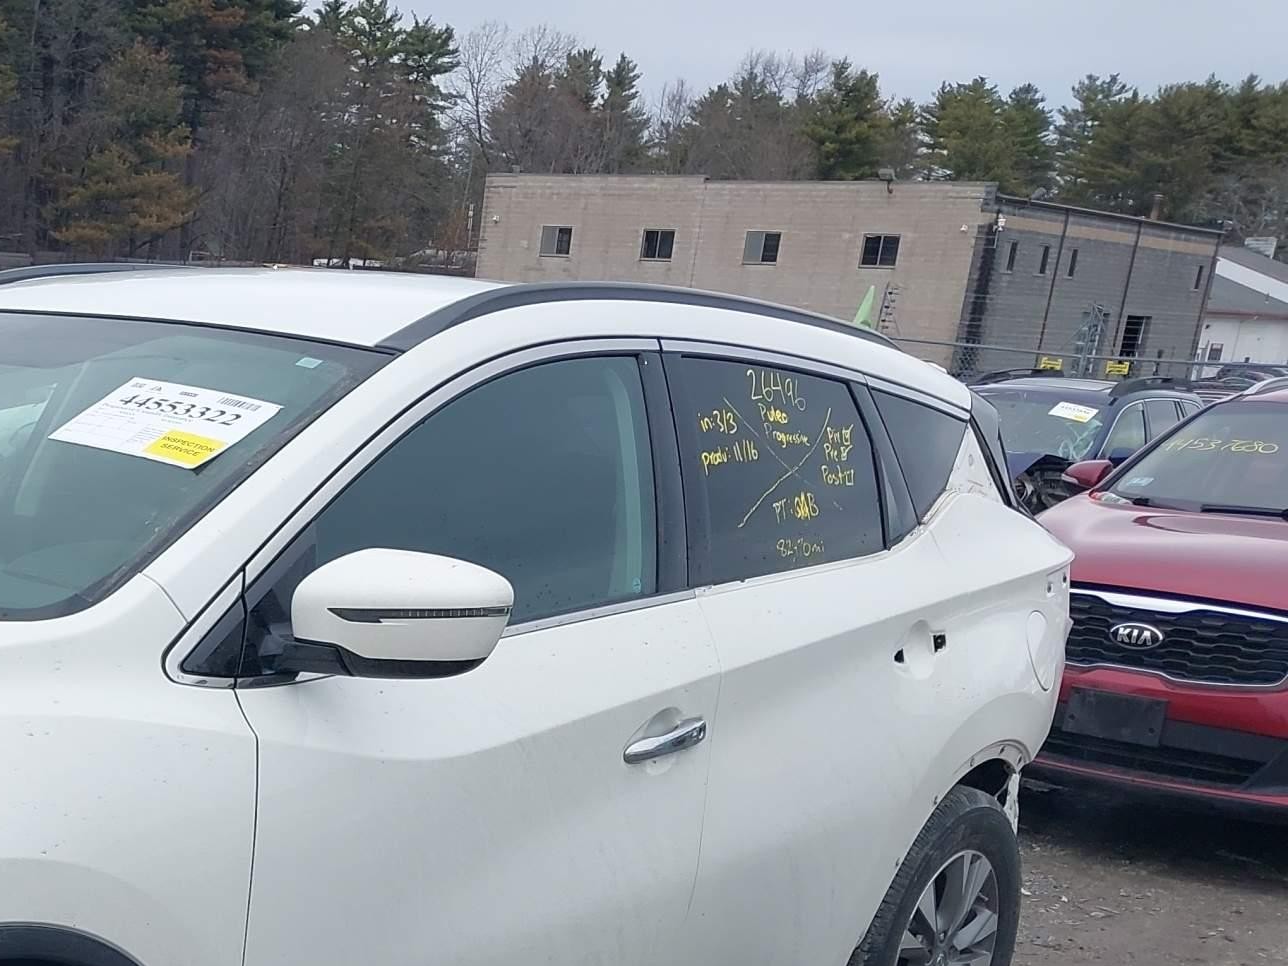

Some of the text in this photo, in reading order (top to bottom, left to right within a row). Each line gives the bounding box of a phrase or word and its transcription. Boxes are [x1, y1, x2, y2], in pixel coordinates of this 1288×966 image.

[747, 369, 806, 411] 26496
[119, 394, 242, 426] 44553322
[160, 443, 201, 457] SERVICE
[162, 435, 216, 453] INSPECTION
[1117, 627, 1153, 646] KIA
